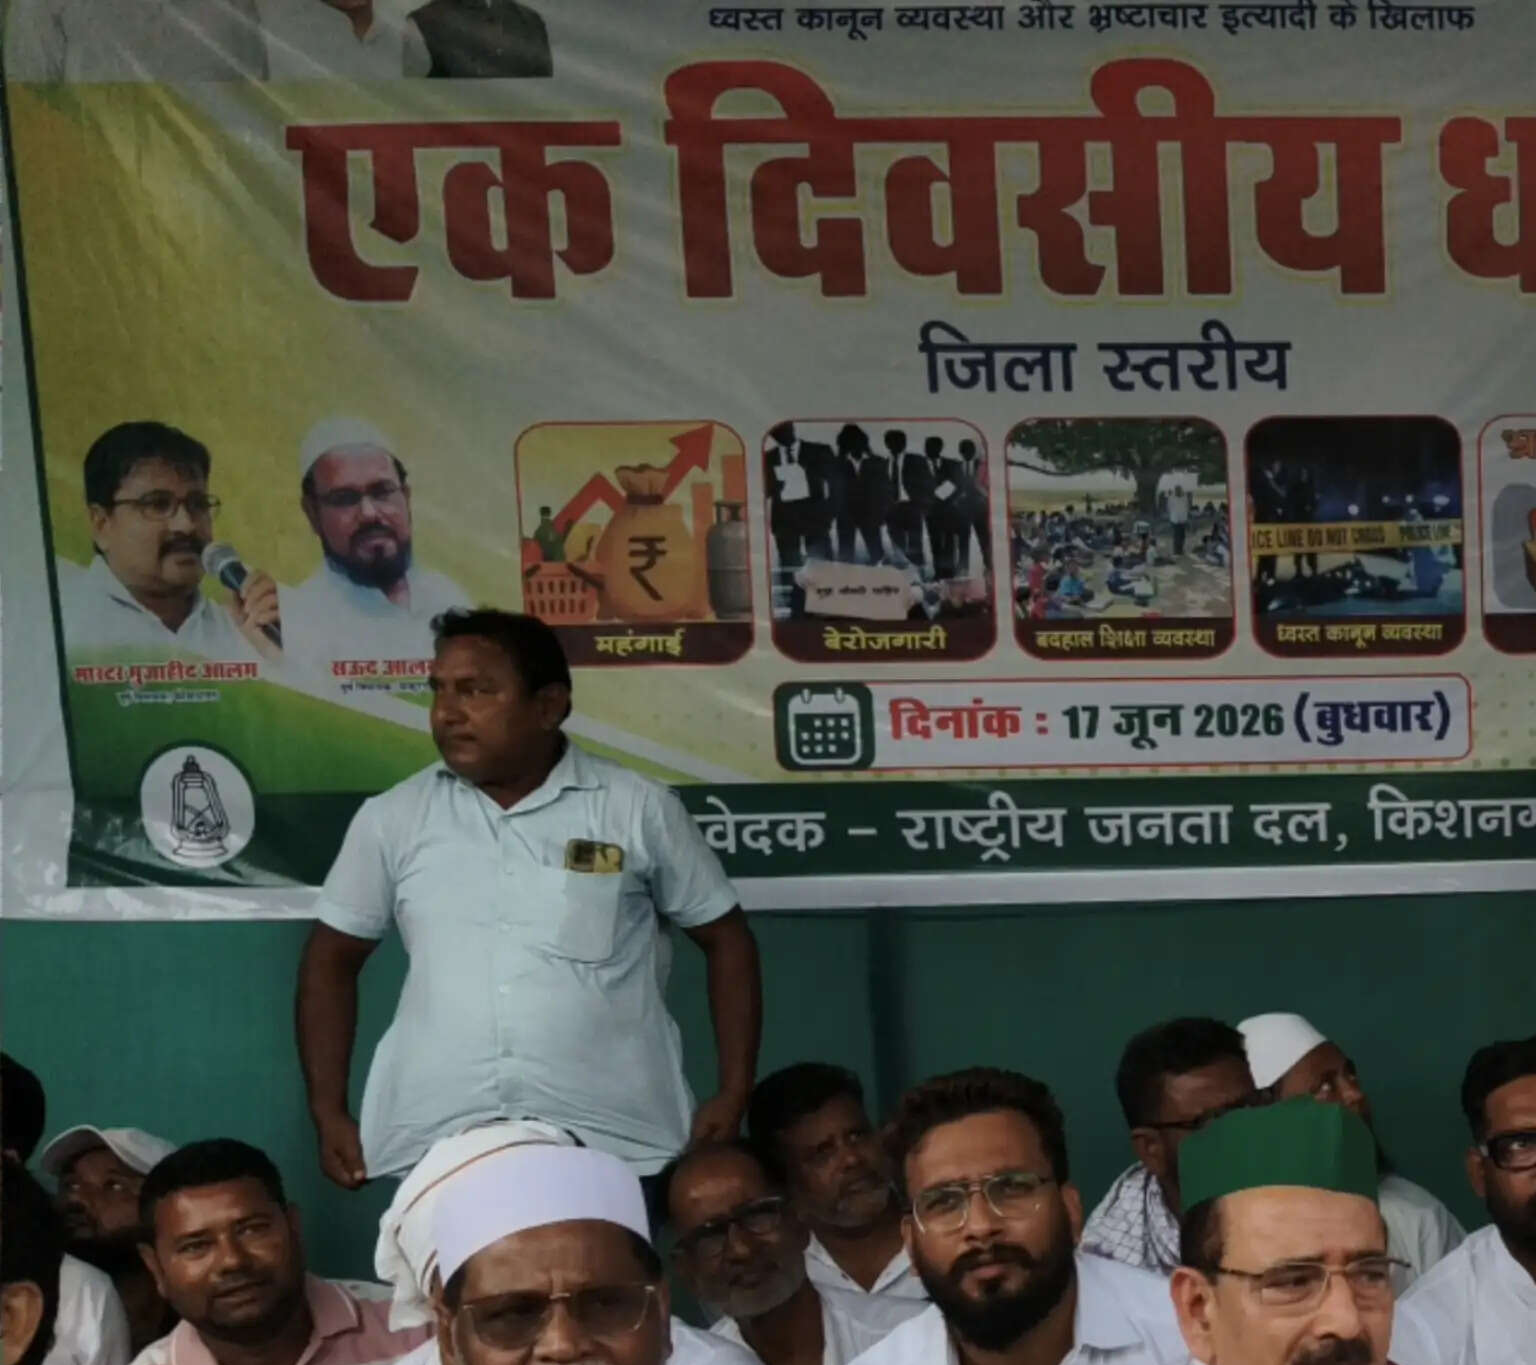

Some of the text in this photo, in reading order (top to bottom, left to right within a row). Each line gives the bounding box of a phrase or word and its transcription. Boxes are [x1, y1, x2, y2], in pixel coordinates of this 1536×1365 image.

[795, 7, 884, 40] कानून
[895, 5, 1004, 31] व्यवस्था
[1018, 0, 1073, 30] और
[1089, 4, 1207, 33] भ्रष्टाचार
[1367, 0, 1476, 30] खिलाफ
[285, 121, 621, 302] एक
[663, 57, 1402, 298] दिवसीय
[919, 319, 1291, 393] जिला स्तरीय
[594, 627, 686, 656] महंगाई
[822, 625, 948, 652] बेरोजगारी
[890, 697, 1022, 741] दिनांक
[1063, 705, 1100, 740] 17
[1113, 703, 1184, 750] जून
[1194, 703, 1285, 738] 2026
[1293, 691, 1451, 745] (बुधवार)
[691, 795, 826, 856] वेदक
[895, 789, 1068, 863] राष्ट्रीय
[1084, 803, 1233, 848] जनता
[1250, 802, 1349, 852] दल,
